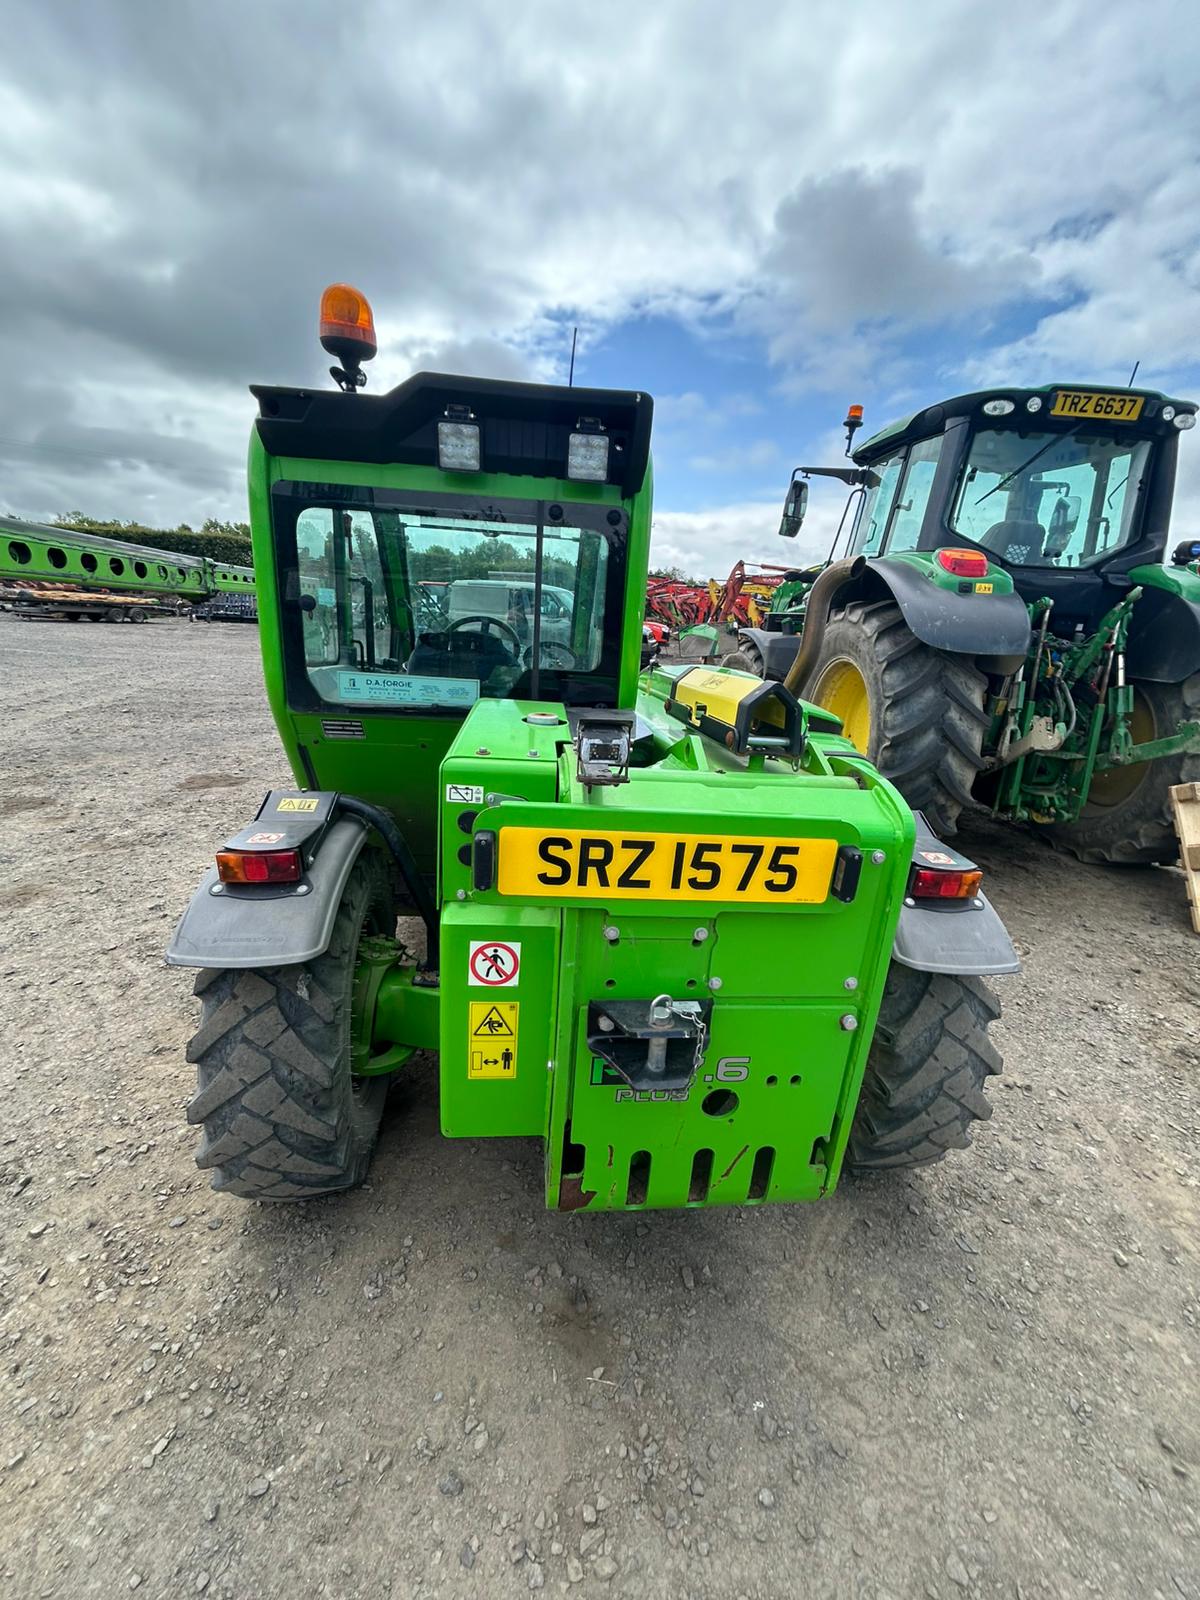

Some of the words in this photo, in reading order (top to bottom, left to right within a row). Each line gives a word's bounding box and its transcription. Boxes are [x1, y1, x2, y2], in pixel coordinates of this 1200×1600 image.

[1060, 393, 1093, 413] TRZ
[1093, 396, 1137, 416] 6637
[537, 836, 656, 888] SRZ
[670, 841, 801, 893] 1575
